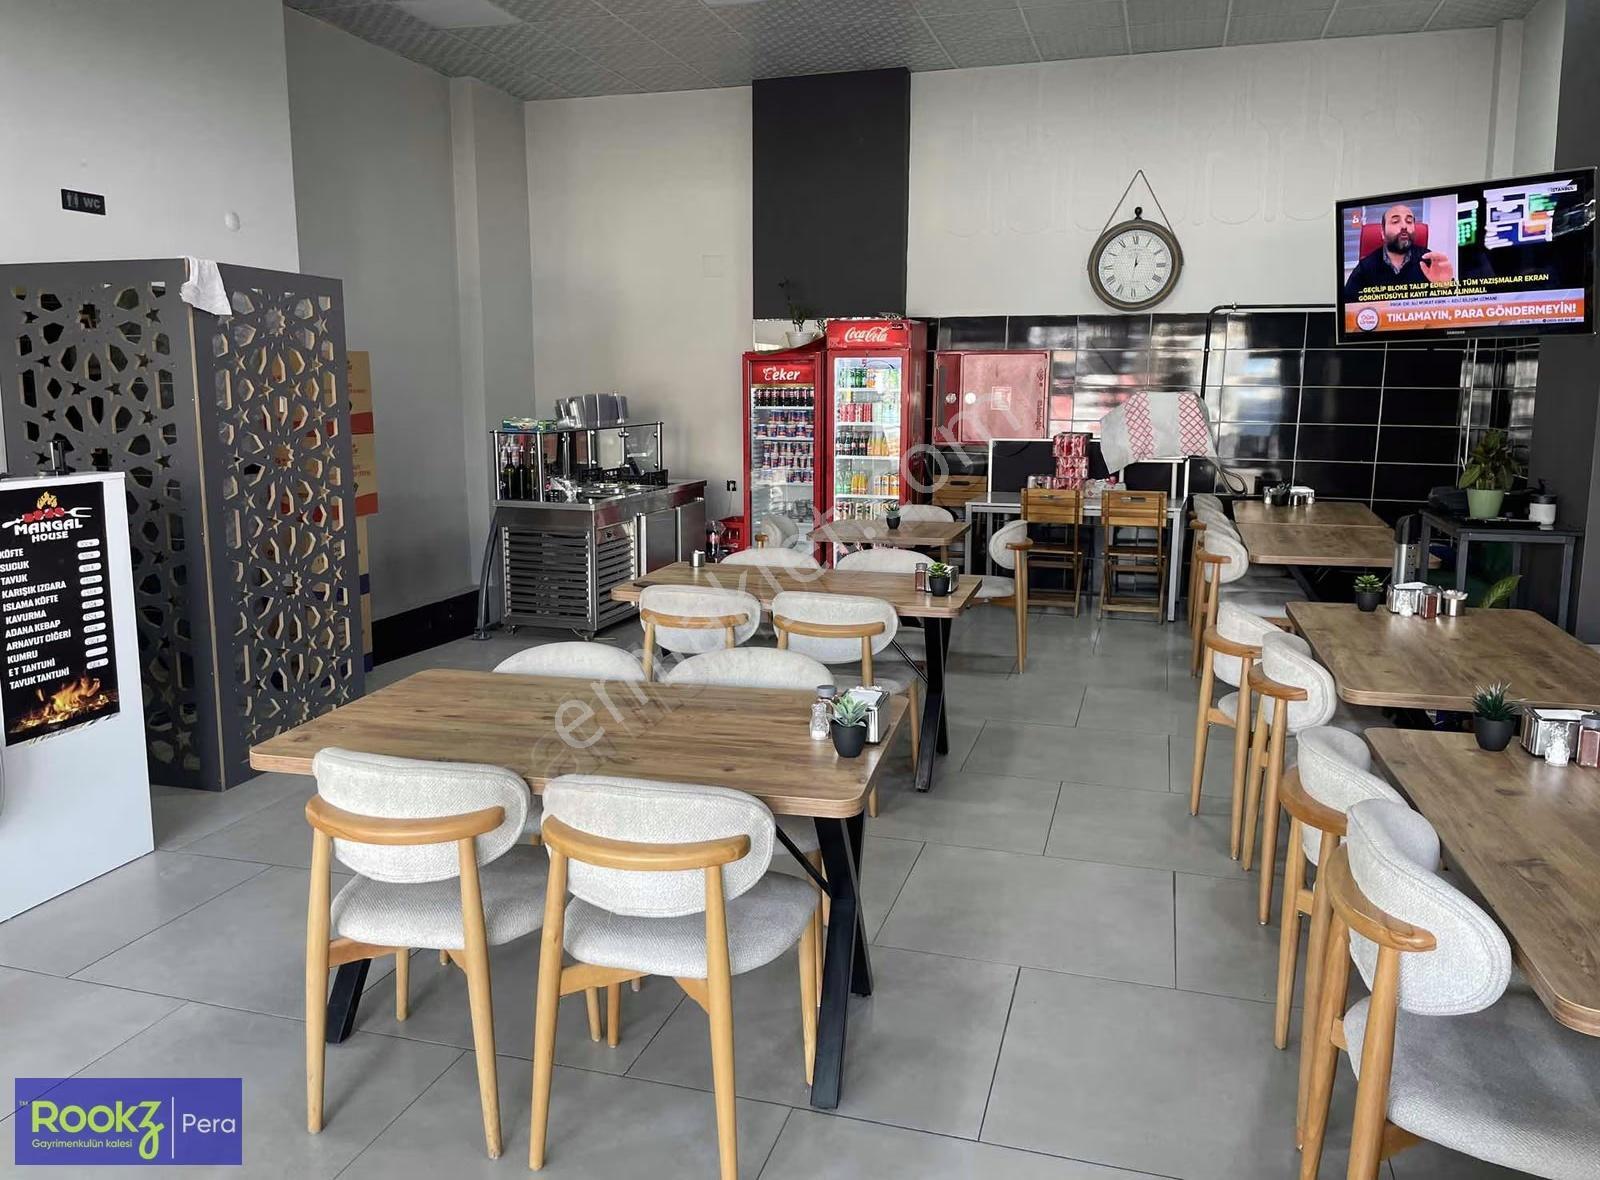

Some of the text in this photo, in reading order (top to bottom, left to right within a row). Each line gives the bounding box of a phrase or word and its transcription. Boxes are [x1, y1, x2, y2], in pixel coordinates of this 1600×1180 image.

[83, 197, 101, 208] WC
[1388, 284, 1408, 292] BLOKE
[1409, 282, 1429, 290] TALEP
[1463, 278, 1478, 286] TÜM
[1480, 275, 1523, 286] YAZIŞMALAR
[1525, 274, 1549, 282] EKRAN
[1429, 289, 1453, 297] ALTINA
[1387, 302, 1577, 322] TIKLAMAYIN, PARA GÖNDERMEYİN!
[14, 518, 83, 536] MANGAL
[31, 531, 69, 543] HOUSE
[0, 560, 30, 573] SUCUK
[1, 574, 28, 586] TAVUK
[2, 580, 66, 599] KARIŞIK IZGARA
[35, 595, 59, 606] KÖFTE
[5, 609, 47, 625] KAVURMA
[5, 619, 61, 639] ADANA KEBAP
[6, 635, 44, 651] ARNAVUT
[7, 649, 38, 664] KUMRU
[21, 657, 56, 674] TANTUNİ
[9, 666, 70, 690] TAVUK TANTUNİ
